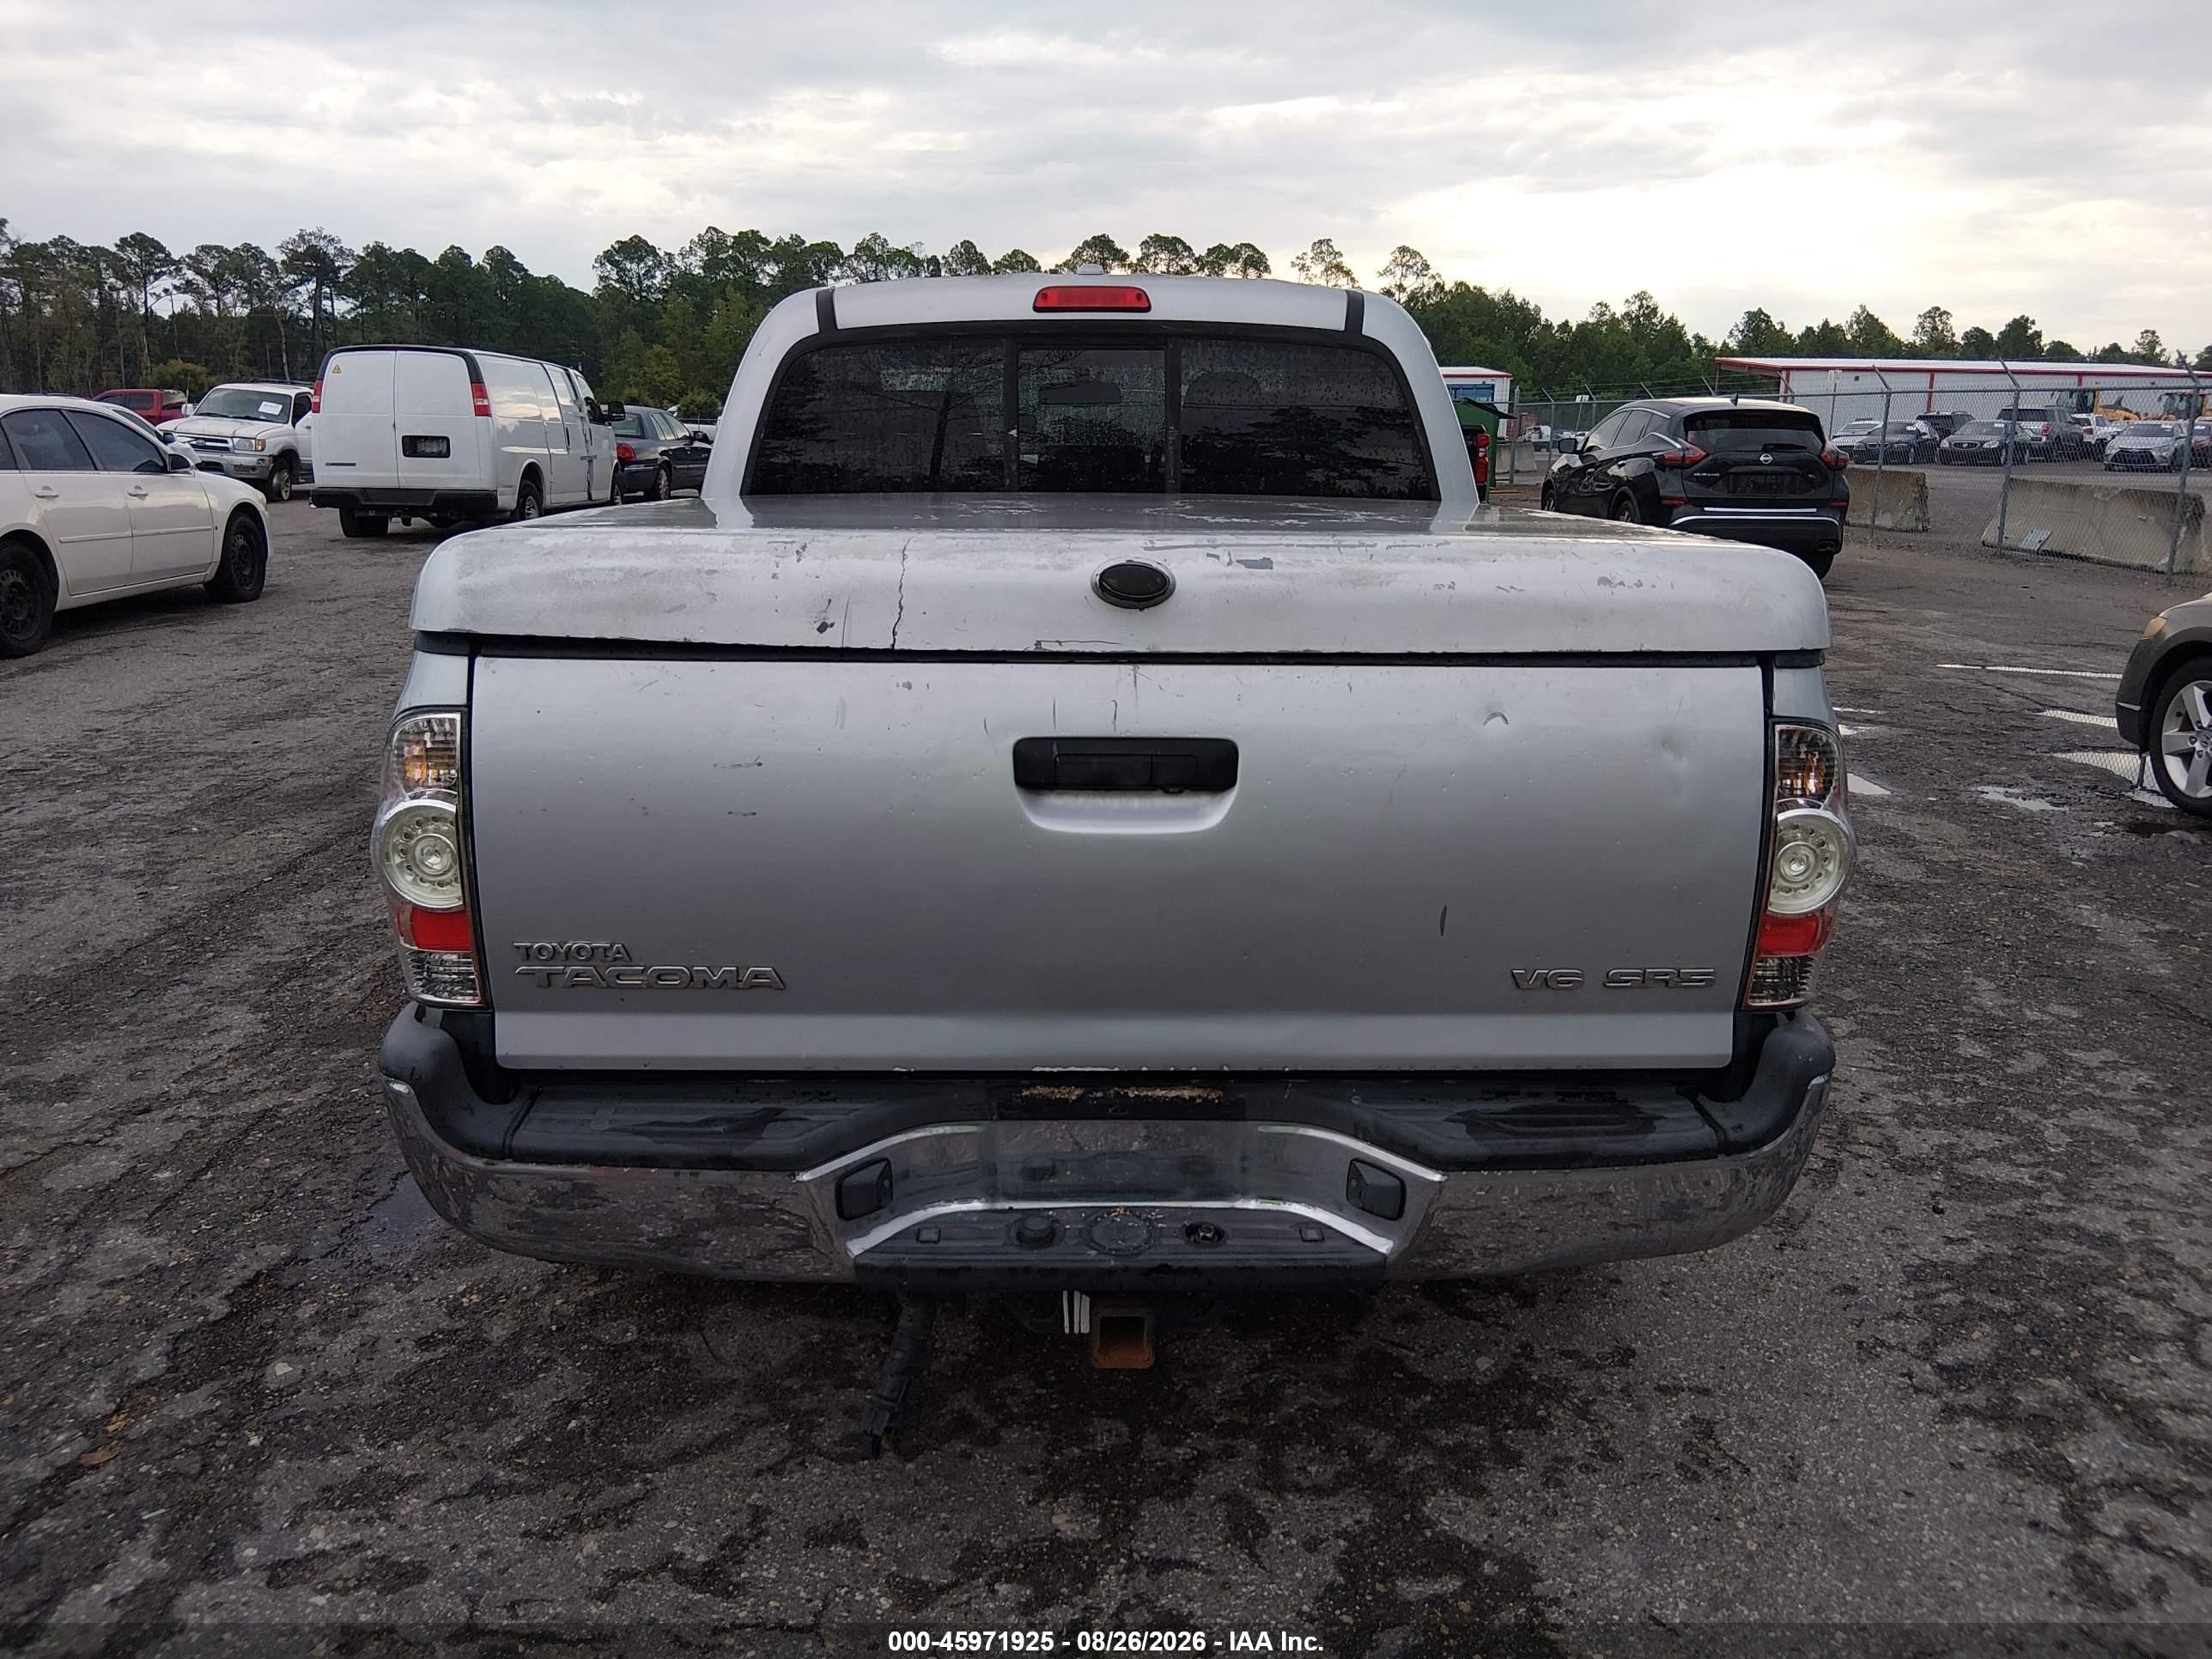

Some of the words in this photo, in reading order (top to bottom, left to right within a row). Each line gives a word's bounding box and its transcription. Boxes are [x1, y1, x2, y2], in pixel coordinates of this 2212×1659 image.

[514, 940, 632, 962] TOYOTA
[515, 965, 786, 989] TACOMA
[1511, 968, 1583, 989] V6
[1603, 968, 1715, 988] SR5
